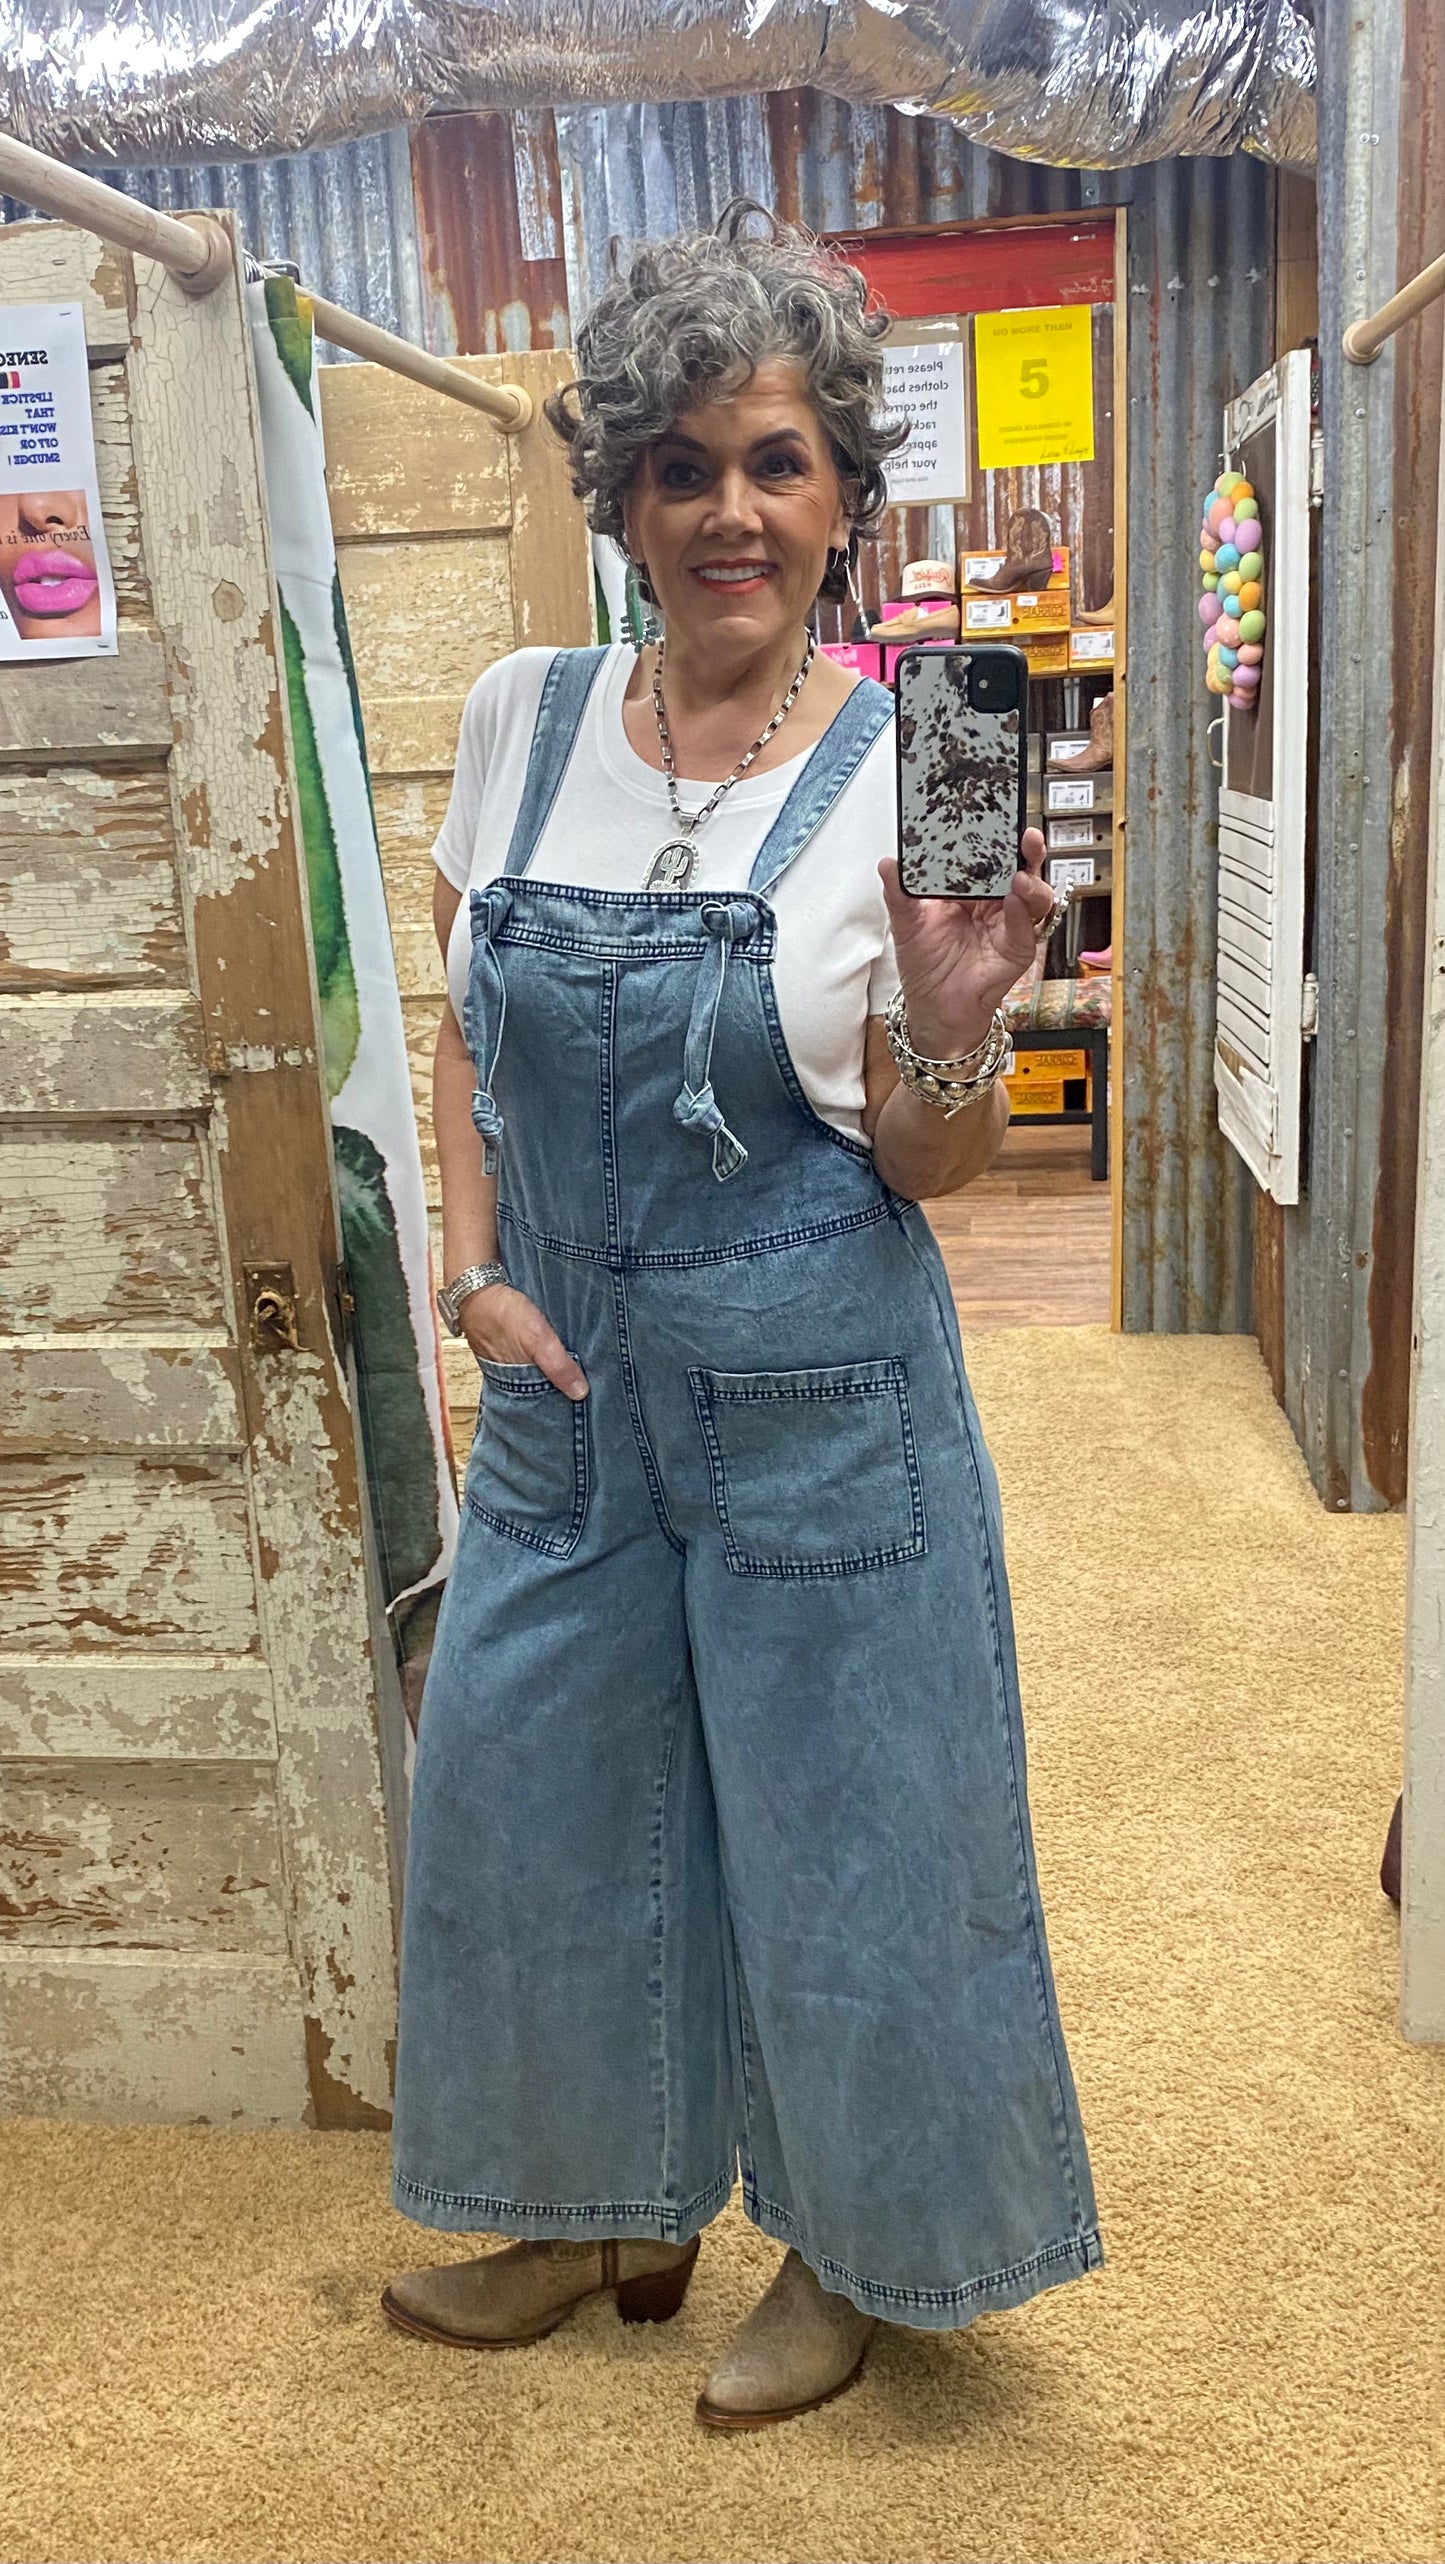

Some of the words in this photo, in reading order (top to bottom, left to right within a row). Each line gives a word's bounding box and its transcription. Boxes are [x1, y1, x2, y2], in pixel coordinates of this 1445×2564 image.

[1011, 325, 1041, 335] MORE
[1044, 322, 1073, 331] THAN
[1019, 358, 1050, 399] 5
